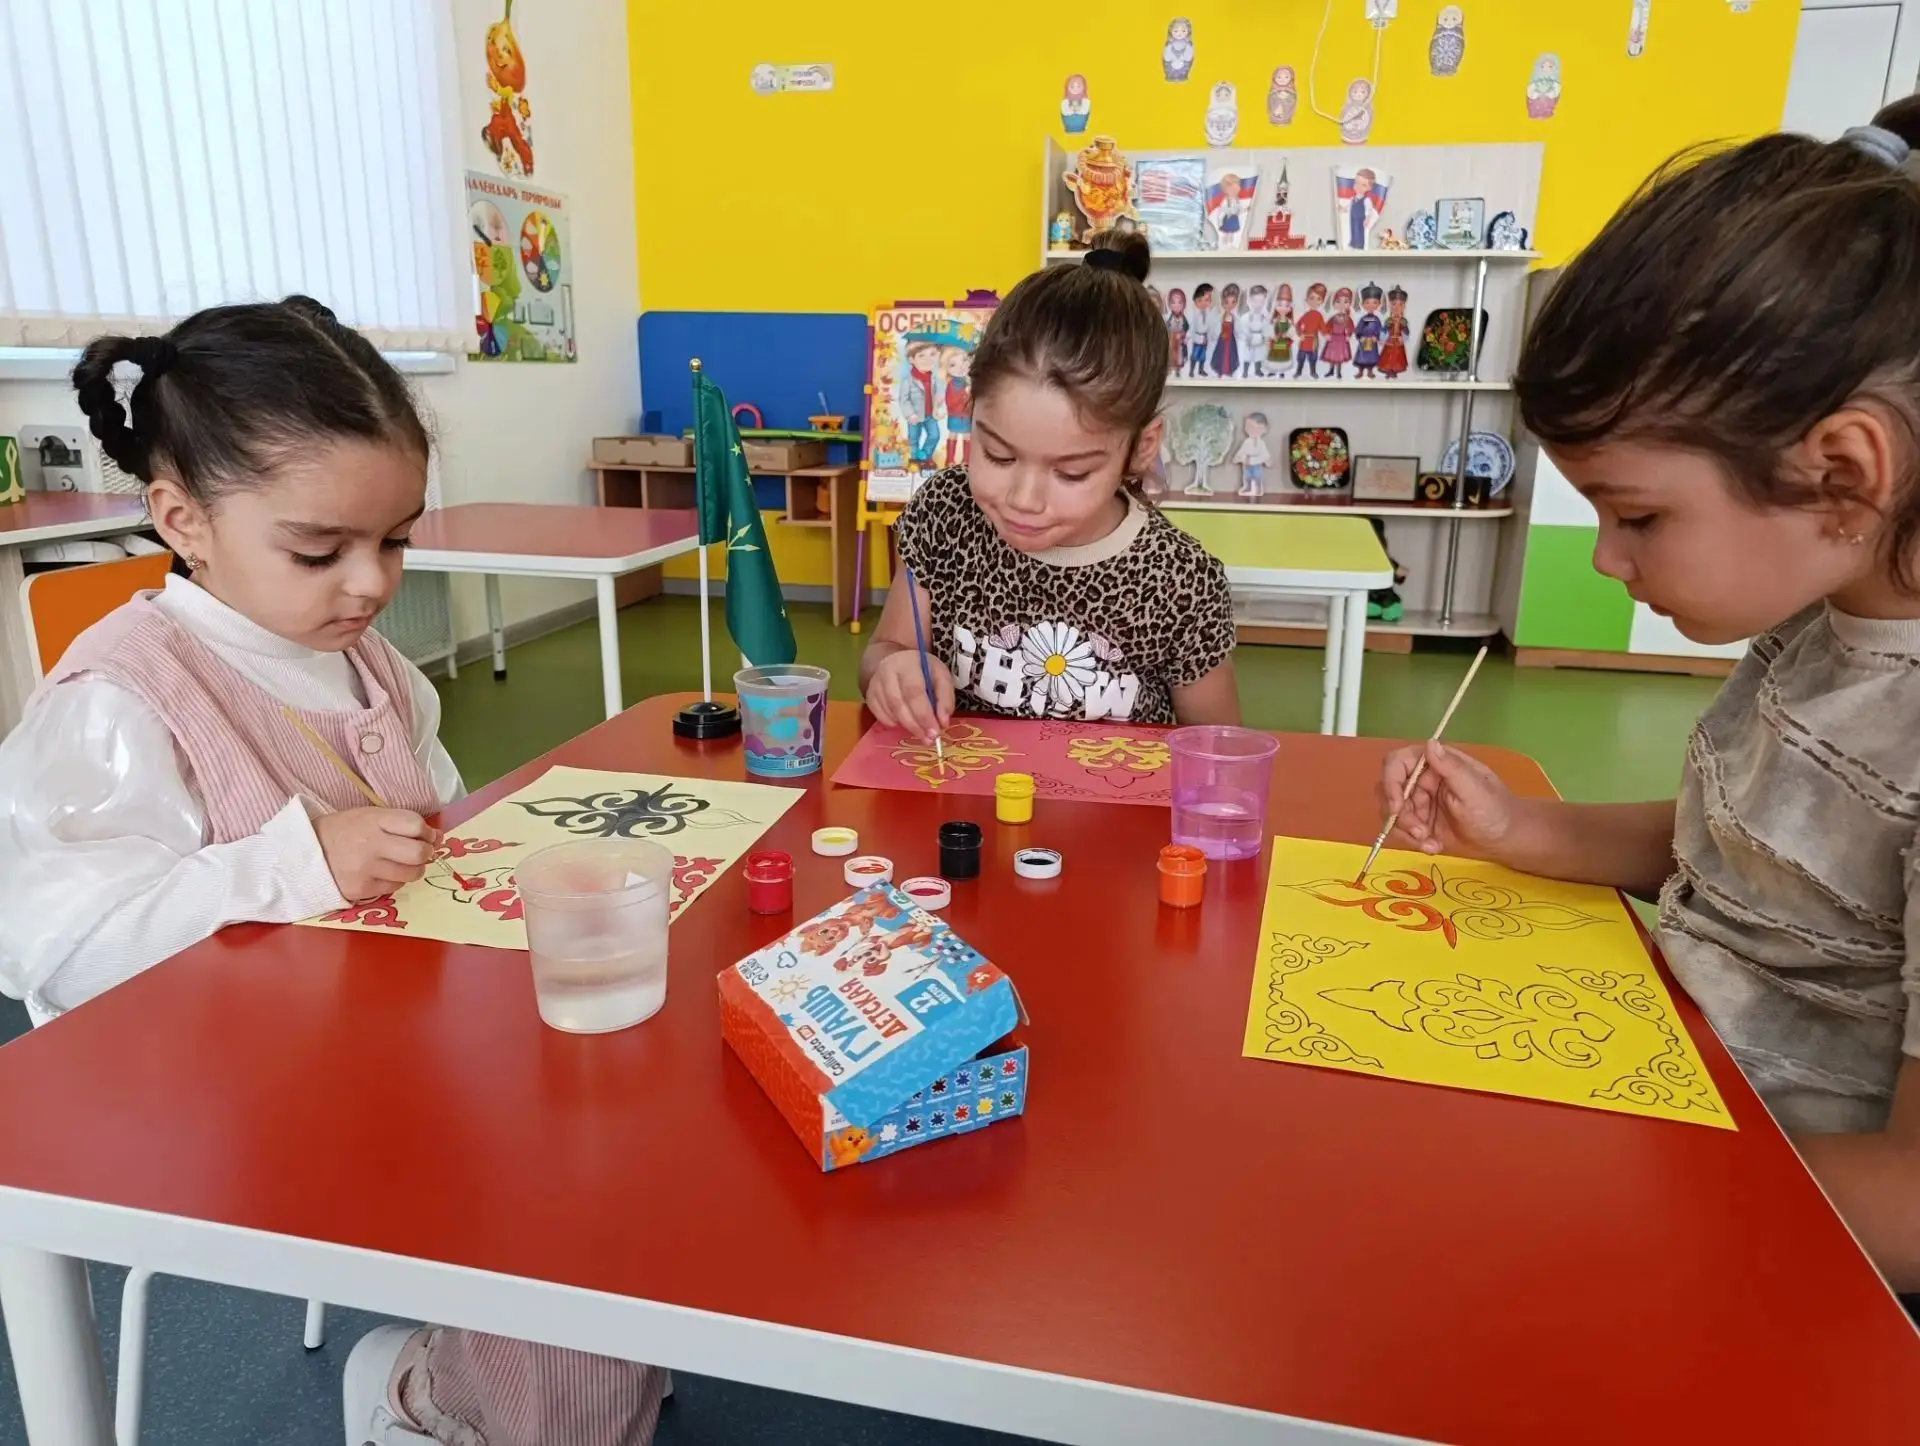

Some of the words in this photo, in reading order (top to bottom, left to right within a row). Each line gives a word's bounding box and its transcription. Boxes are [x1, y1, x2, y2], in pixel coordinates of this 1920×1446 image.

[798, 984, 882, 1063] ГУАШЬ
[838, 977, 908, 1038] ДЕТСКАЯ
[910, 990, 939, 1013] 12
[809, 1037, 845, 1076] Calligrata
